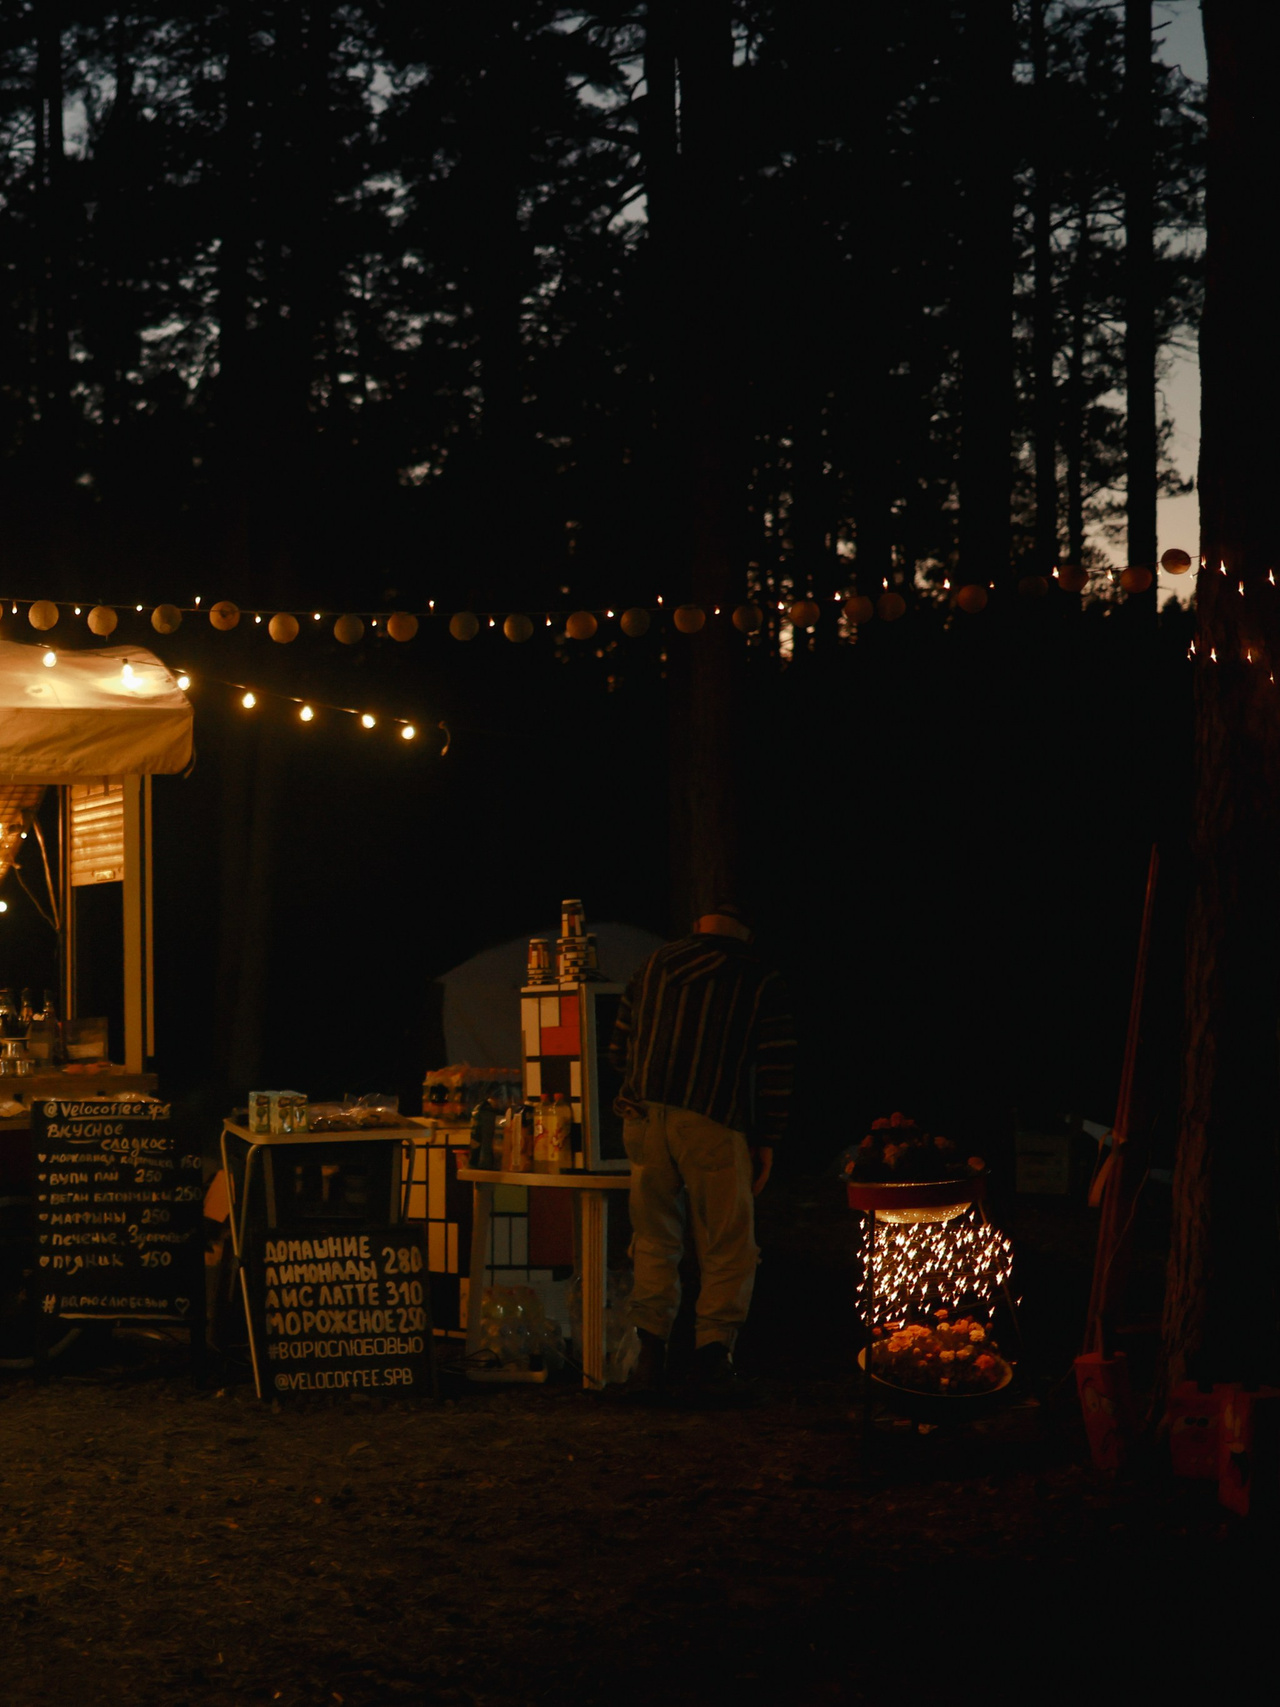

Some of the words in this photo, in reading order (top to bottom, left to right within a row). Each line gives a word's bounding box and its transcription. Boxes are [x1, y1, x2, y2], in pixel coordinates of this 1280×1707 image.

[134, 1168, 163, 1184] 250
[140, 1250, 173, 1268] 150
[263, 1235, 372, 1264] ДОМАШНИЕ
[265, 1259, 379, 1287] ЛИМОНАДЫ
[380, 1245, 424, 1275] 280
[319, 1282, 380, 1307] ЛАТТЕ
[385, 1280, 424, 1307] 310
[265, 1308, 396, 1336] МОРОЖЕНОЕ
